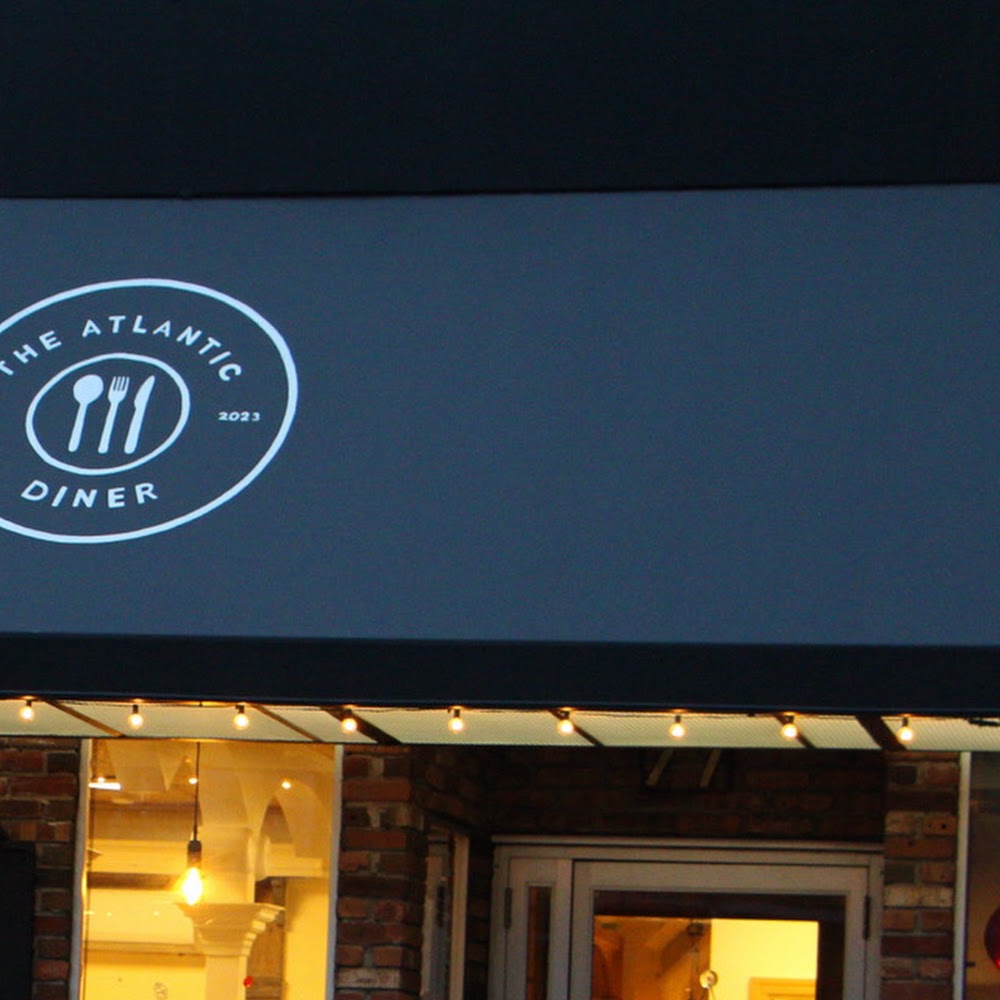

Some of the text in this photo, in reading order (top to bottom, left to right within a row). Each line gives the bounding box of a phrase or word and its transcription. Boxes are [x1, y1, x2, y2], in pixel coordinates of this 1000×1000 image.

[82, 315, 242, 383] ATLANTIC
[218, 410, 261, 422] 2023
[21, 478, 159, 509] DINER
